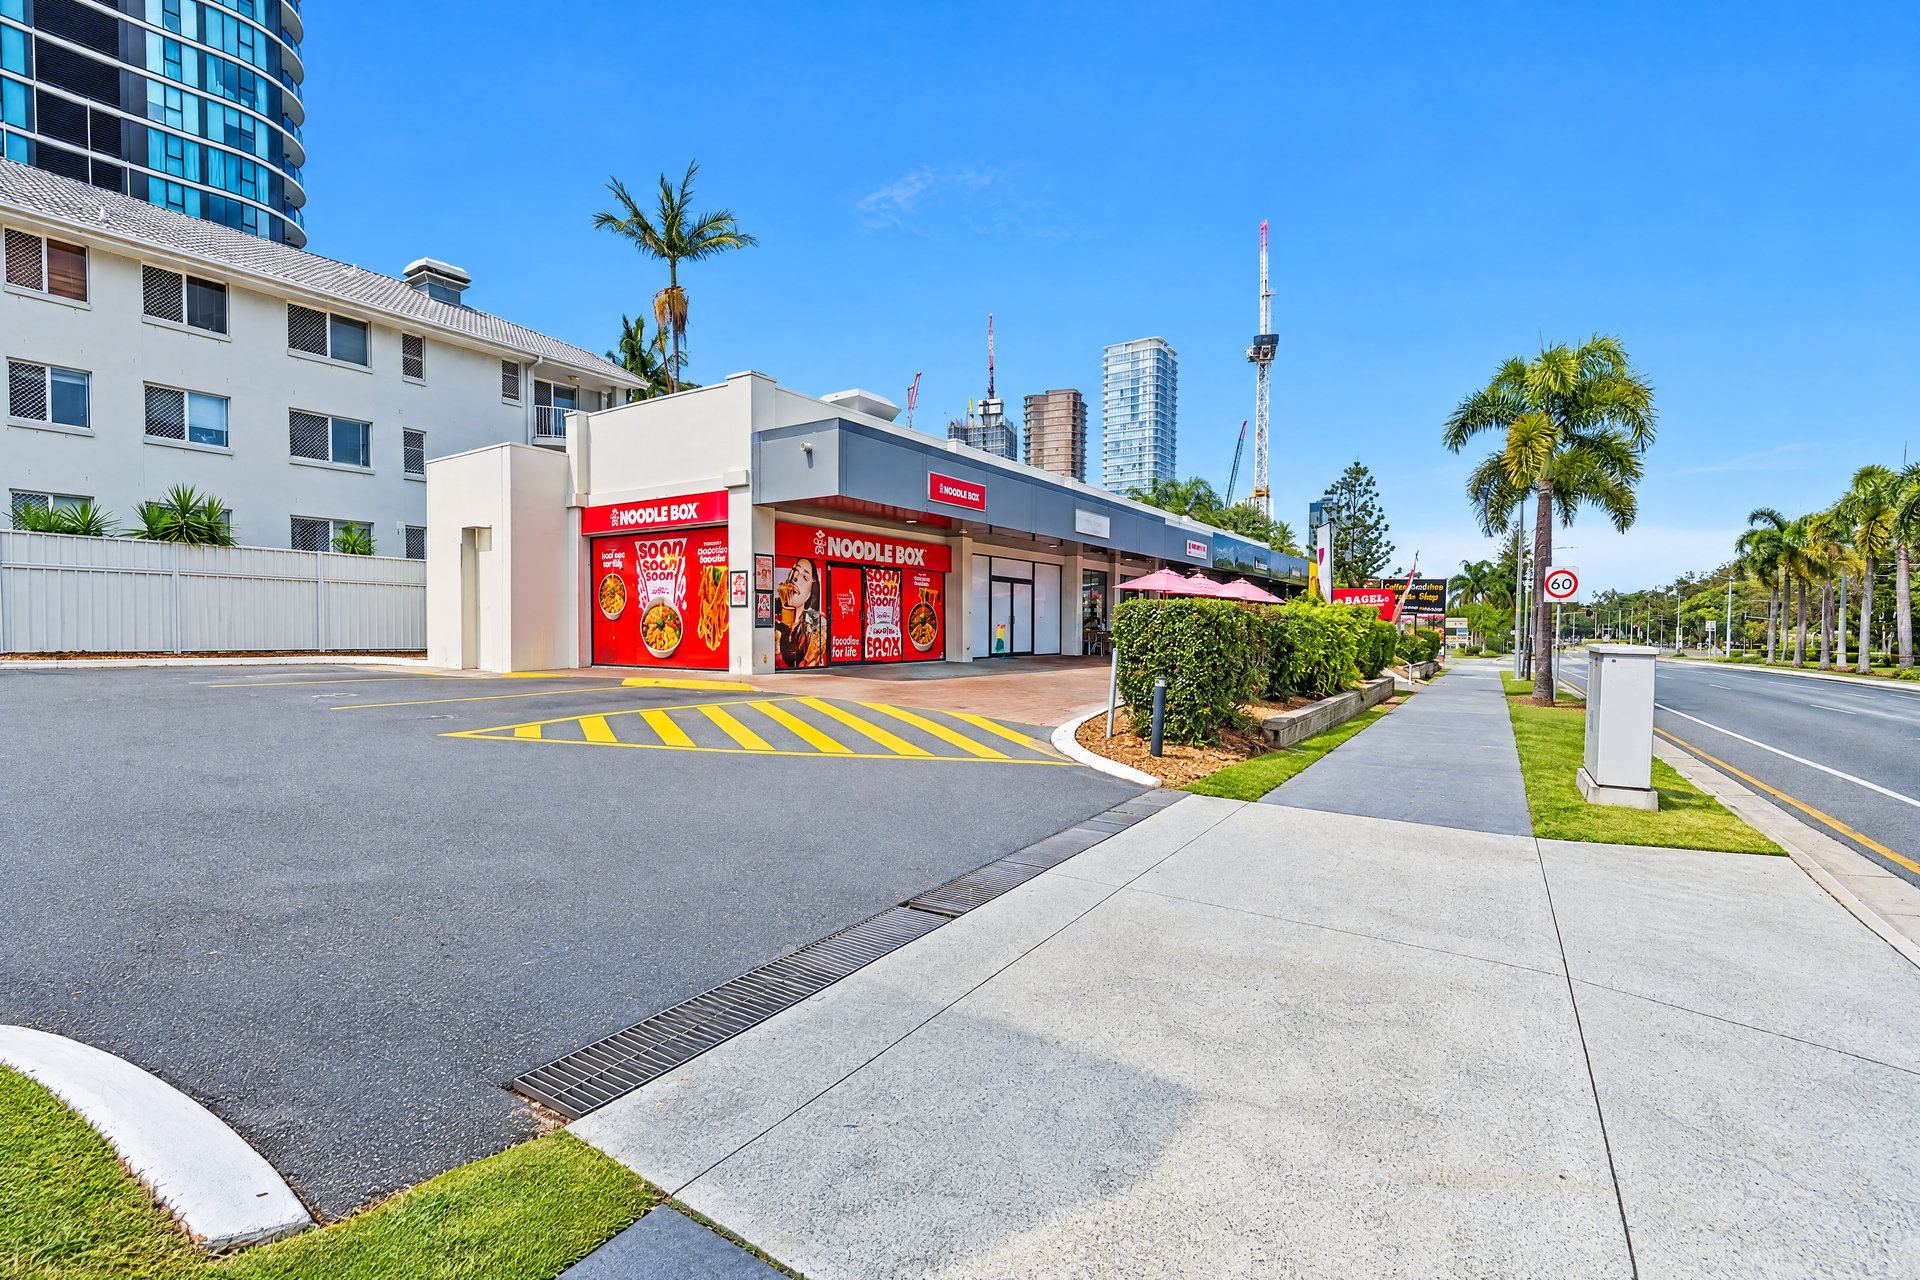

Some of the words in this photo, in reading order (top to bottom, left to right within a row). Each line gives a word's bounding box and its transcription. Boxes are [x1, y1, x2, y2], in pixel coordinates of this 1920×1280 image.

[944, 485, 968, 499] NOODLE
[968, 491, 980, 502] BOX
[620, 505, 668, 526] NOODLE
[670, 502, 699, 521] BOX
[827, 536, 893, 563] NOODLE
[895, 545, 925, 566] BOX
[1551, 578, 1572, 590] 60
[845, 646, 858, 657] life
